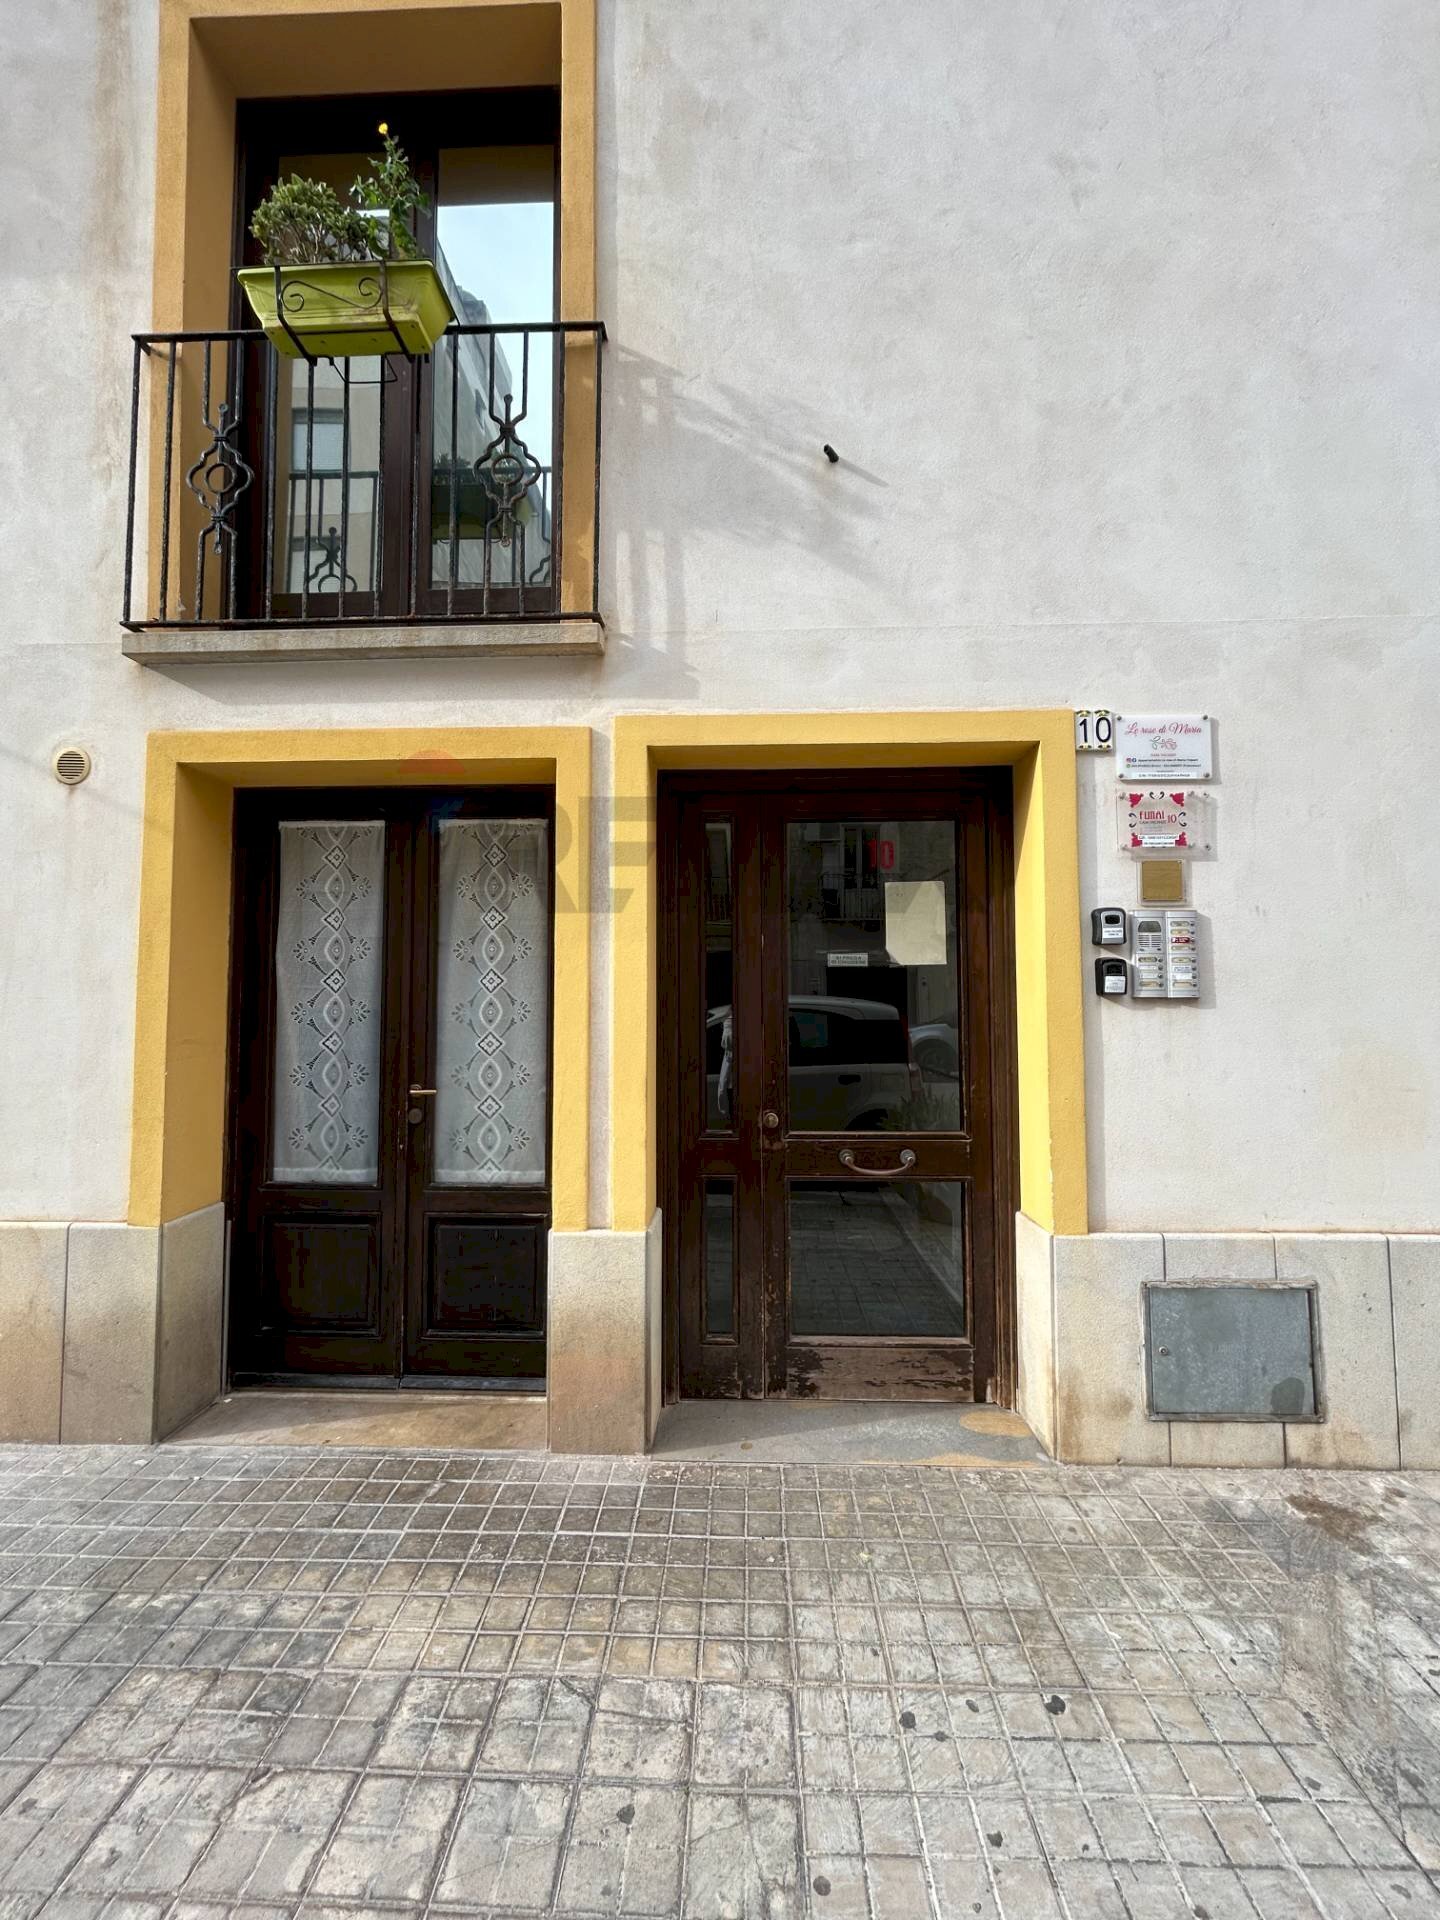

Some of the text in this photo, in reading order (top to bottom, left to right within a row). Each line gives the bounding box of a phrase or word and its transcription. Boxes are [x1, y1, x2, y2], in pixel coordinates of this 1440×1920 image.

[1079, 717, 1111, 743] 10
[1158, 724, 1167, 734] di
[1168, 722, 1202, 735] Maria
[1167, 814, 1177, 824] 10
[866, 839, 895, 869] 10
